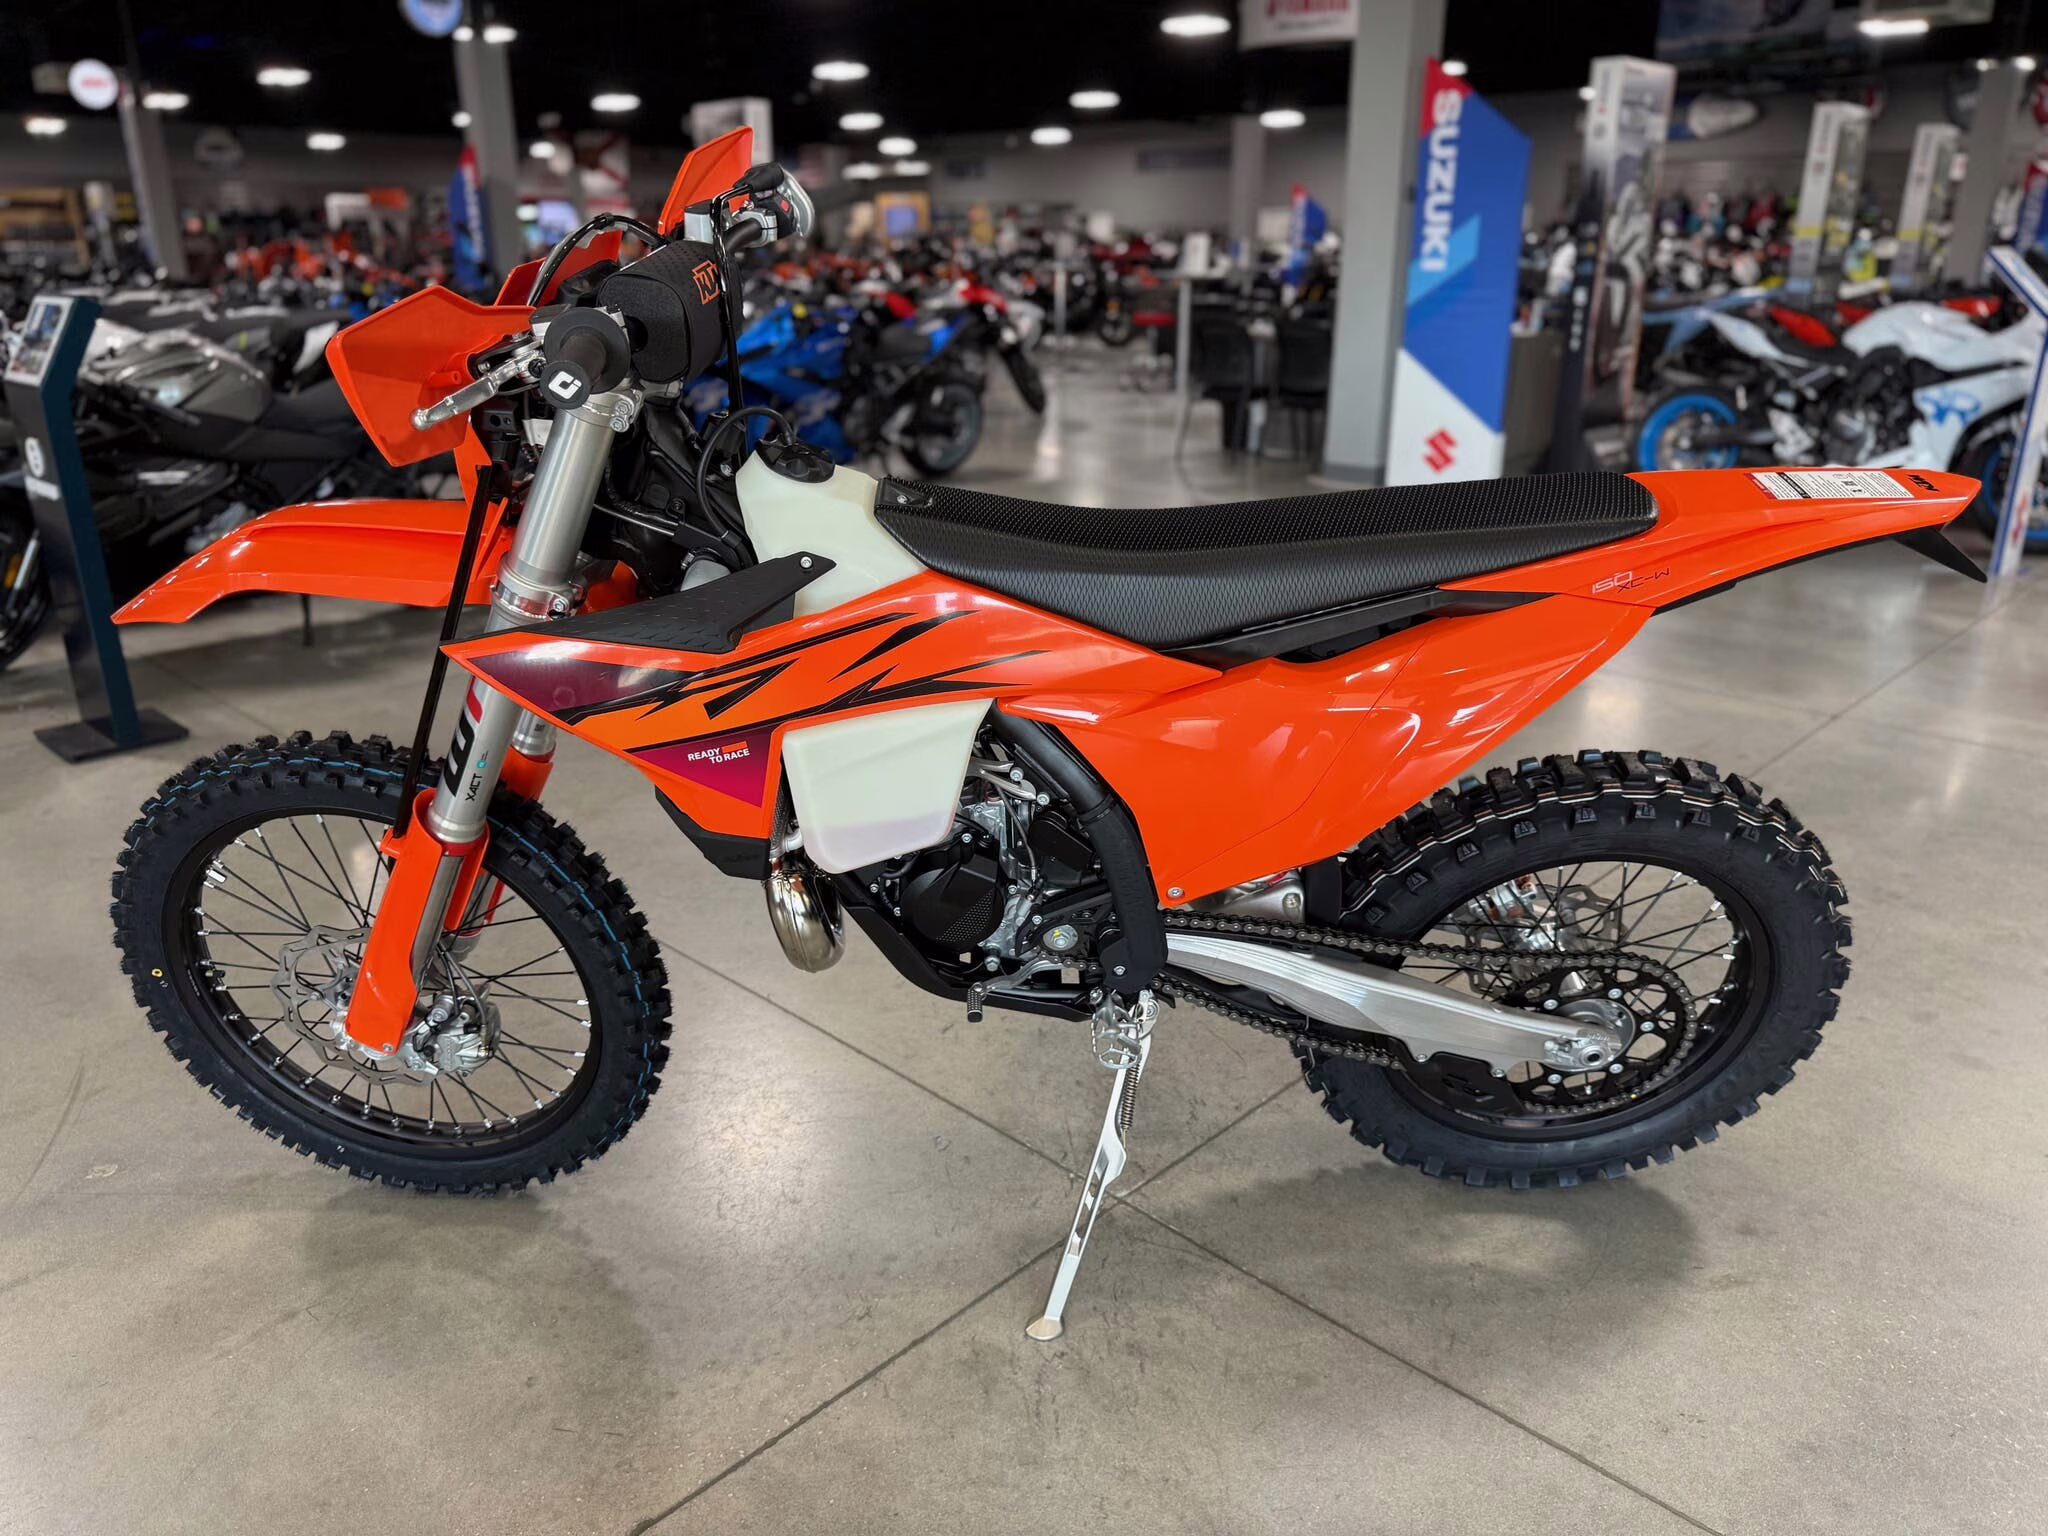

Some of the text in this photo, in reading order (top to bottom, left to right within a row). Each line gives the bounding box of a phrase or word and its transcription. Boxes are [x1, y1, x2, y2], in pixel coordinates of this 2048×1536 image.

[1419, 88, 1463, 272] SUZUKI
[1592, 567, 1669, 595] 150 XC-W
[687, 747, 721, 762] READY
[709, 748, 751, 764] TO RACE
[465, 773, 483, 801] XACT
